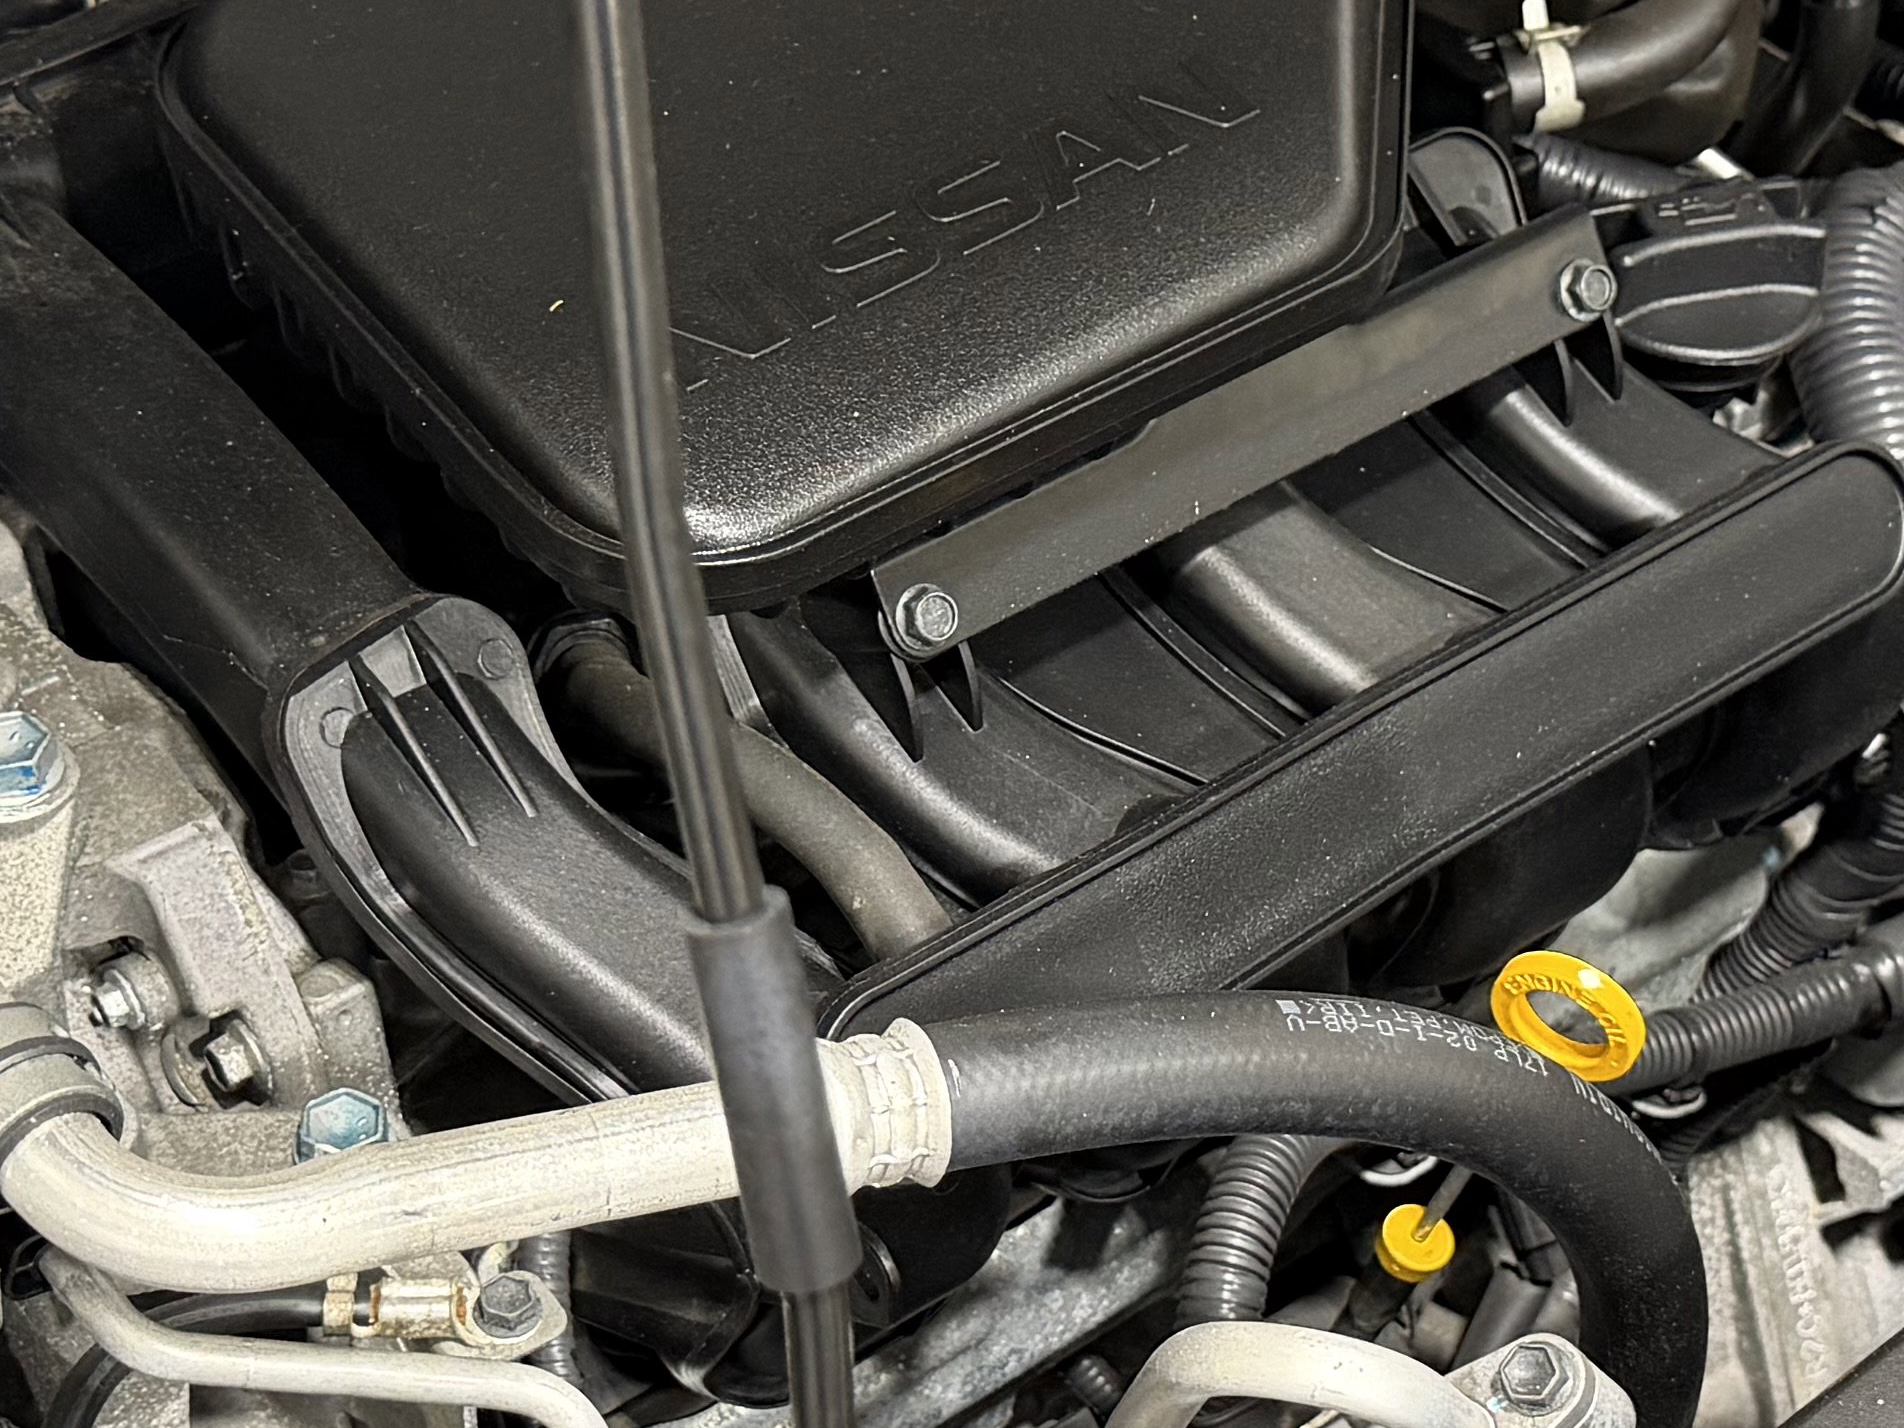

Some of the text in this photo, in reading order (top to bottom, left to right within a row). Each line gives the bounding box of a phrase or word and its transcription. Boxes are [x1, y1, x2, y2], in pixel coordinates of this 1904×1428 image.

[631, 59, 1261, 390] NISSAN
[1503, 973, 1627, 1048] ENGINE OIL
